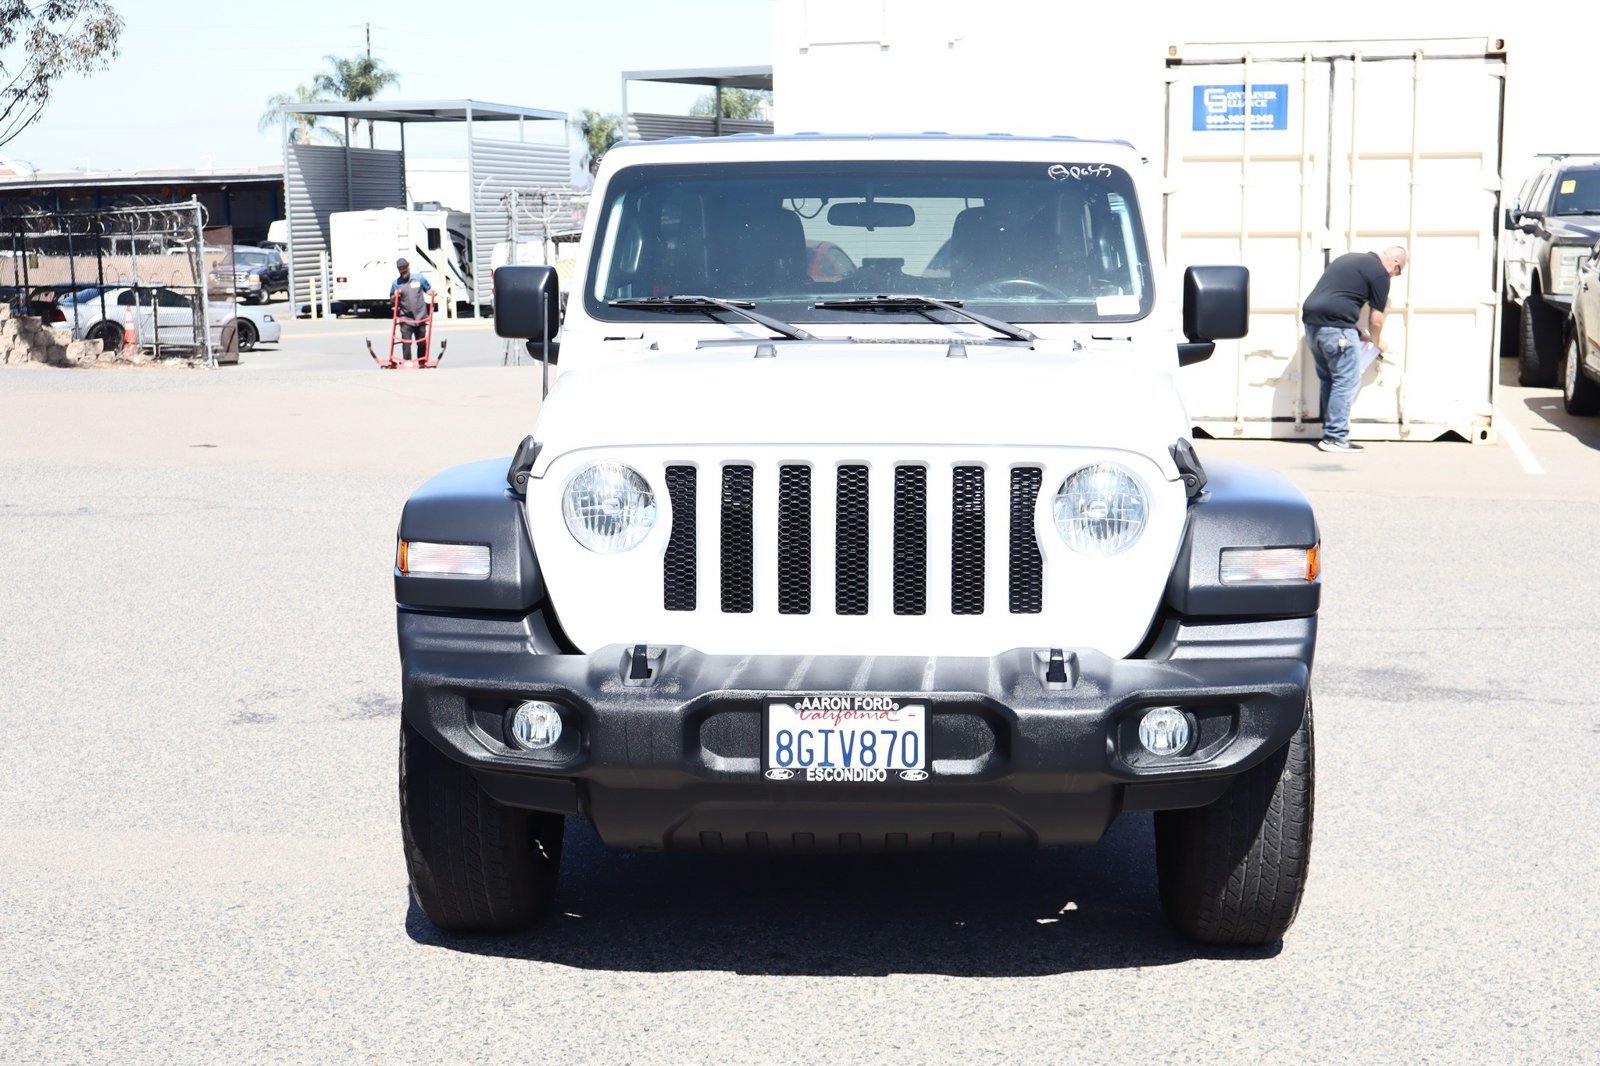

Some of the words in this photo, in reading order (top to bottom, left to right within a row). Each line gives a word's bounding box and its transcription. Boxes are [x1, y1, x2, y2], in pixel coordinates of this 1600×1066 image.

[801, 697, 851, 711] AARON
[854, 697, 893, 711] FORD
[800, 708, 900, 726] California
[775, 729, 919, 768] 8GIV870
[806, 768, 888, 782] ESCONDIDO
